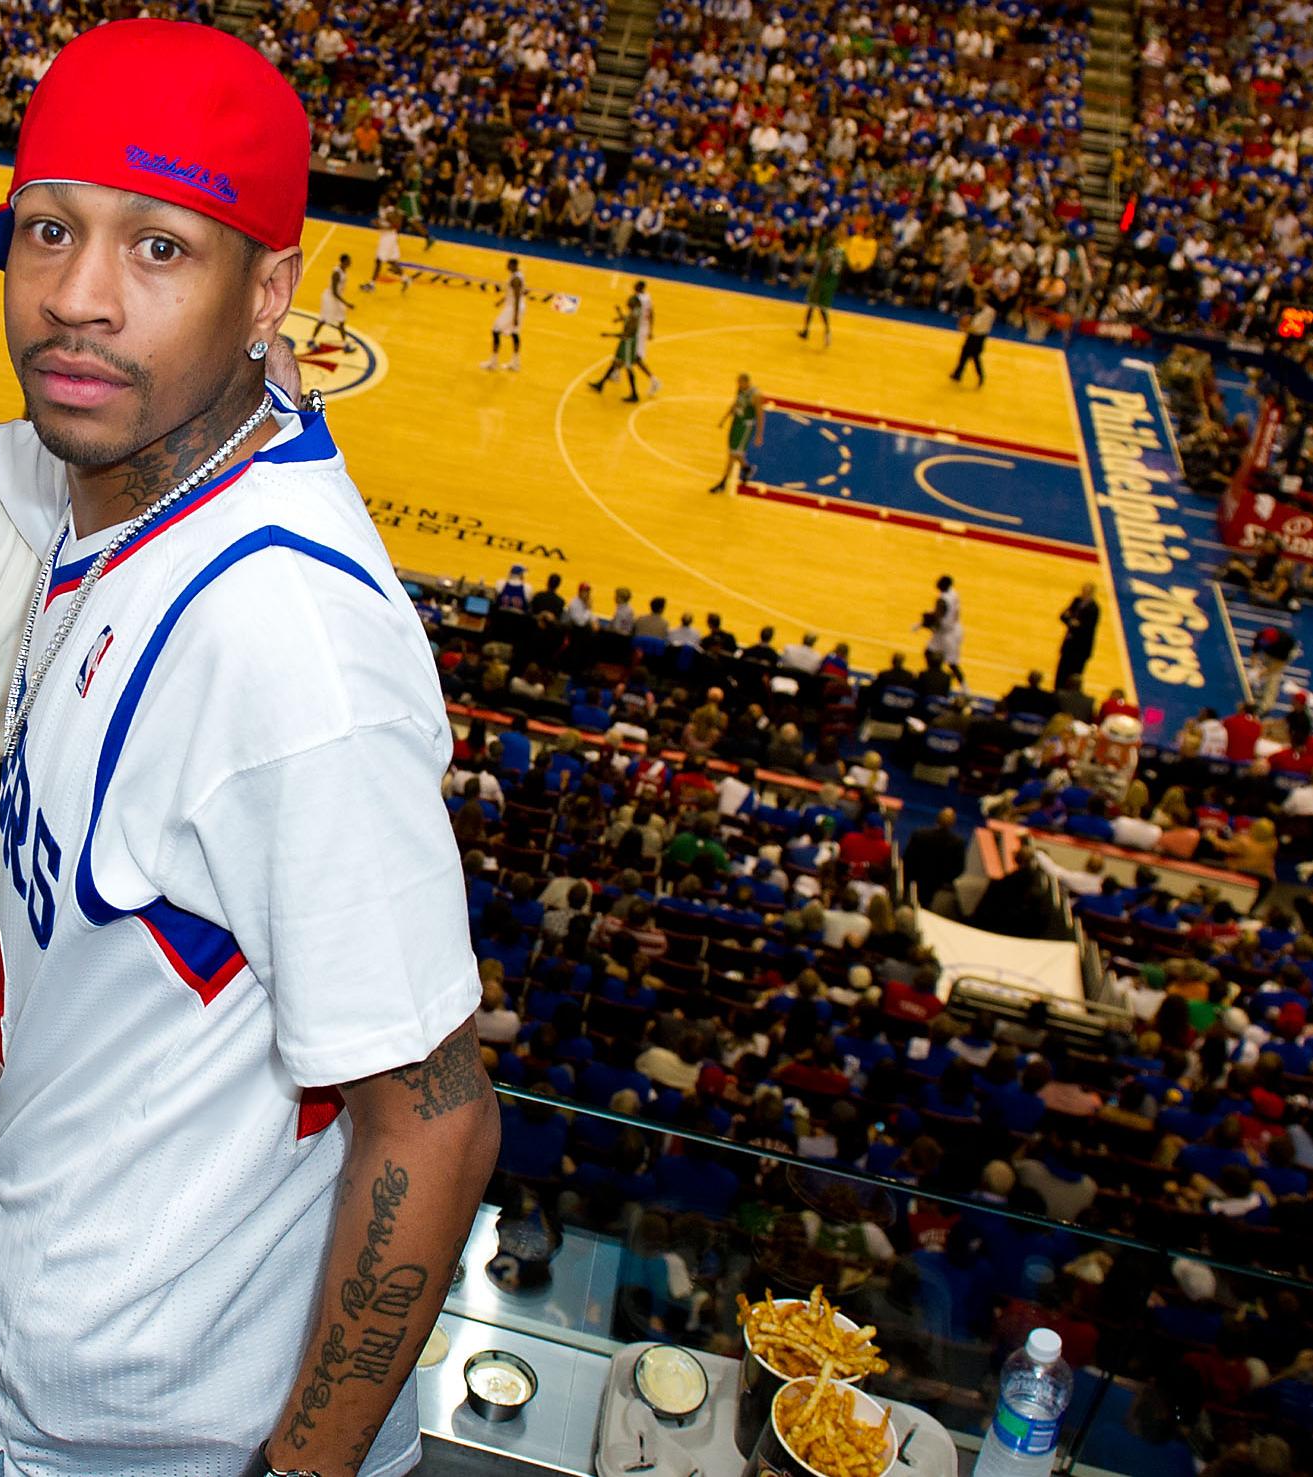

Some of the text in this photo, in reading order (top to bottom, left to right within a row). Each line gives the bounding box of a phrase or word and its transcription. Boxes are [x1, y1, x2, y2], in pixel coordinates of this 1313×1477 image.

[1085, 383, 1190, 574] Philadelphia
[416, 521, 569, 562] WELLS
[1128, 577, 1209, 688] 76ers
